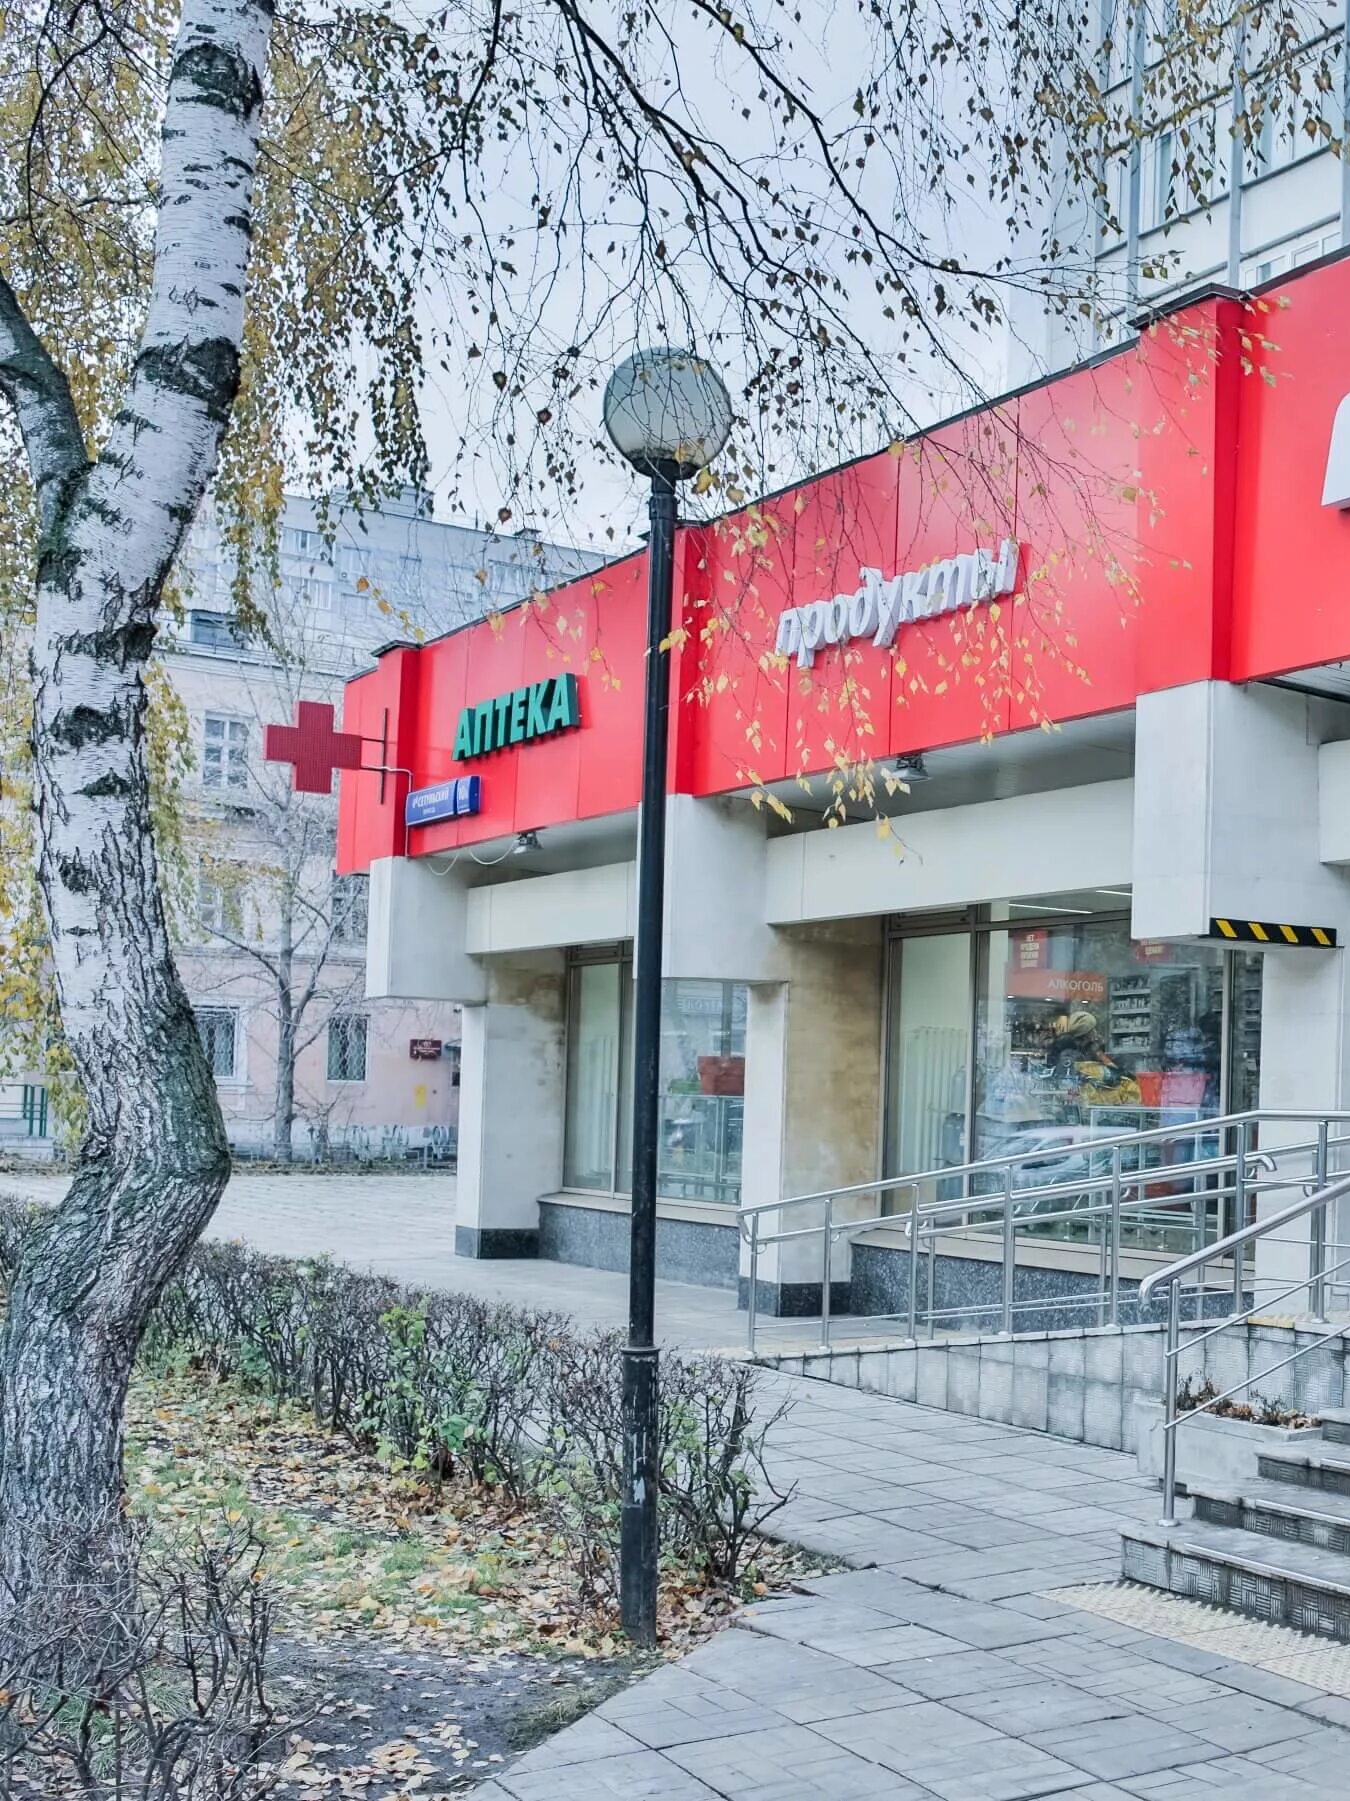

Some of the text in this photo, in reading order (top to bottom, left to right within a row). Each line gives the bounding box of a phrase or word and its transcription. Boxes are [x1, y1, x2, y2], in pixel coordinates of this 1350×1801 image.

[775, 537, 1020, 668] продукты
[452, 672, 579, 761] АПТЕКА
[1047, 977, 1104, 993] АЛКОГОЛЬ
